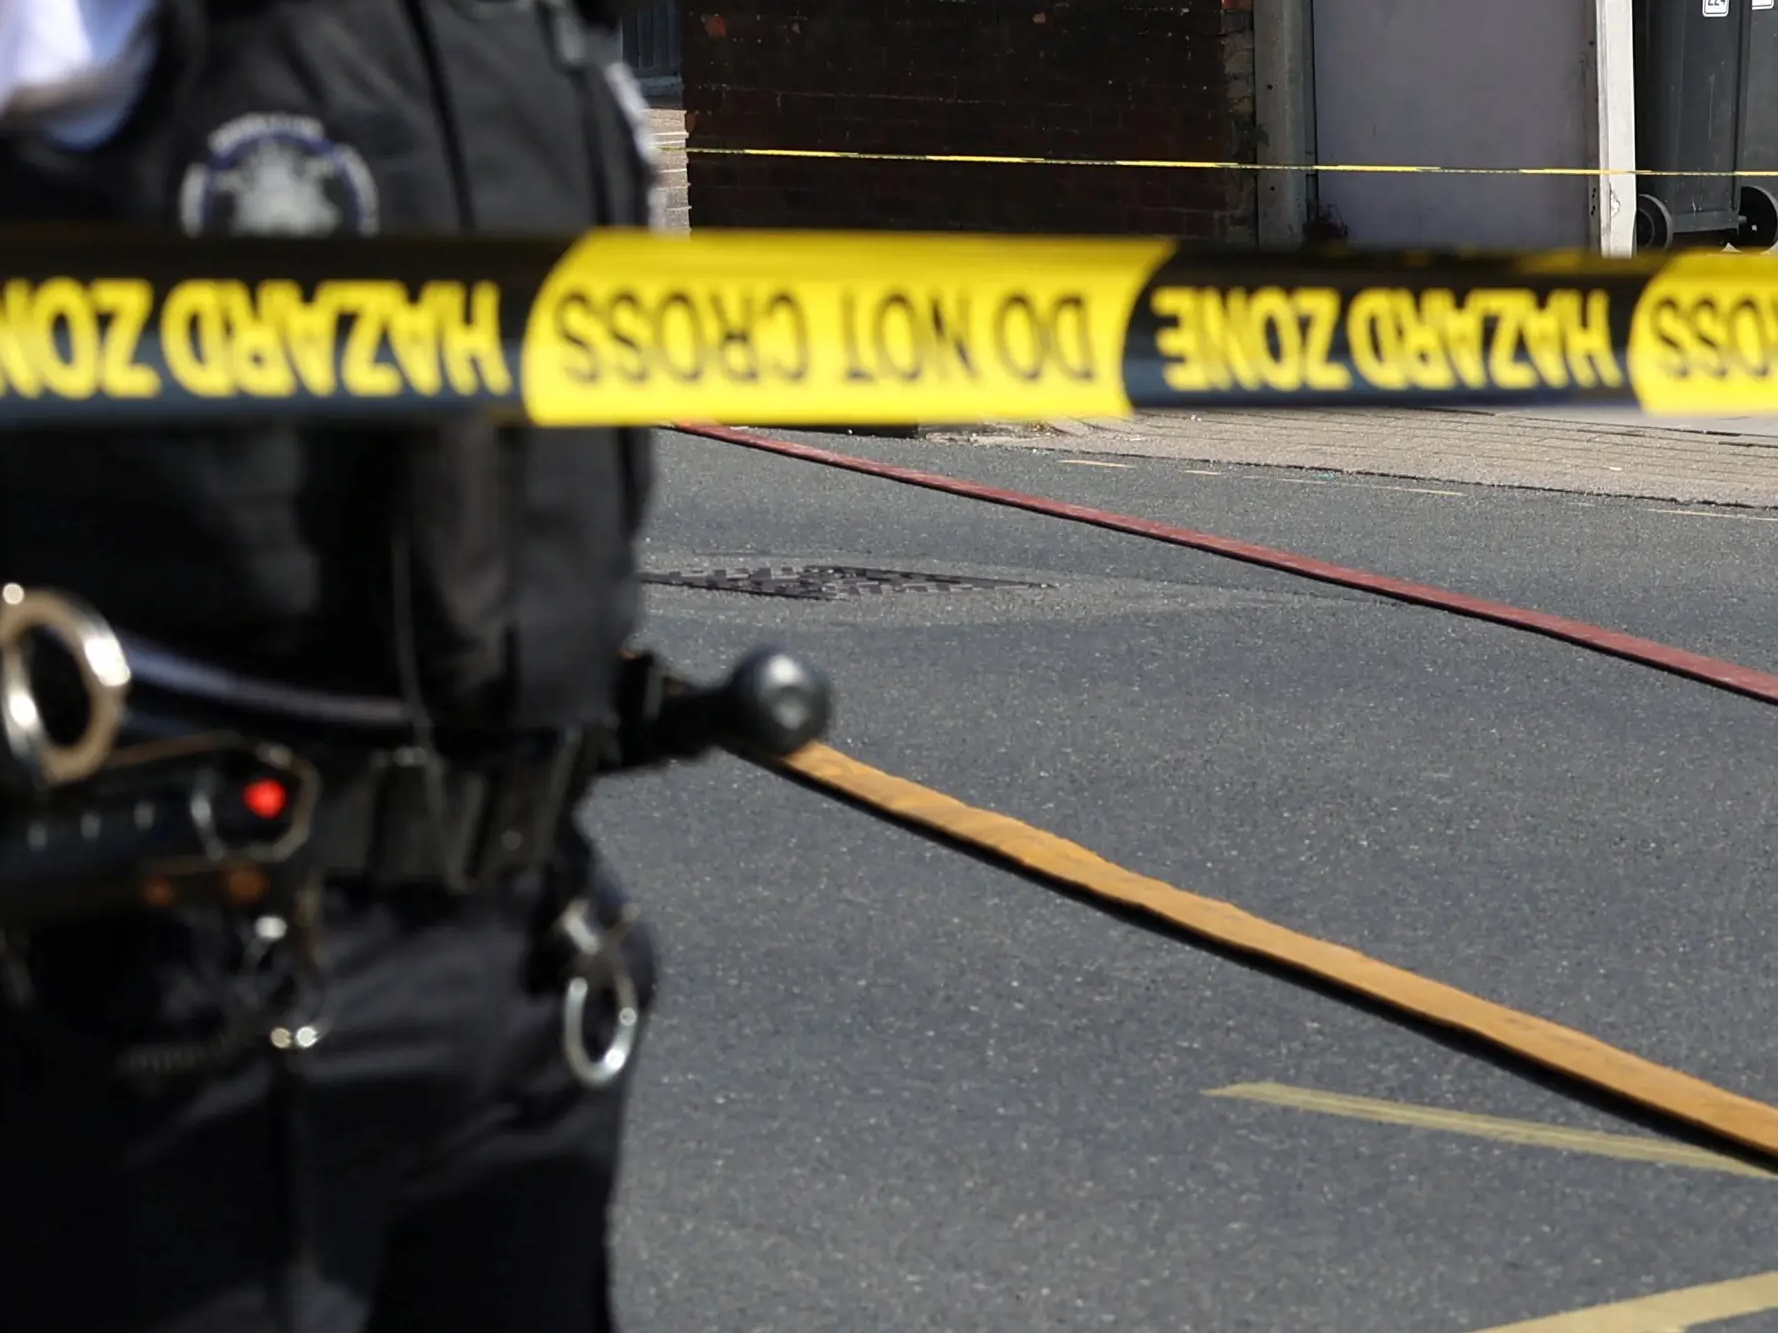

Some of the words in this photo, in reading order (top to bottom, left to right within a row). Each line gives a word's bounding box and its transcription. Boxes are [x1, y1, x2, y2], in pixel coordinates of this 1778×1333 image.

[160, 279, 511, 398] HAZARD
[553, 287, 810, 386] CROSS
[844, 289, 977, 385] NOT
[994, 292, 1096, 383] DO
[1149, 286, 1352, 392] ZONE
[1346, 285, 1623, 391] HAZARD
[1648, 295, 1777, 381] OSS
